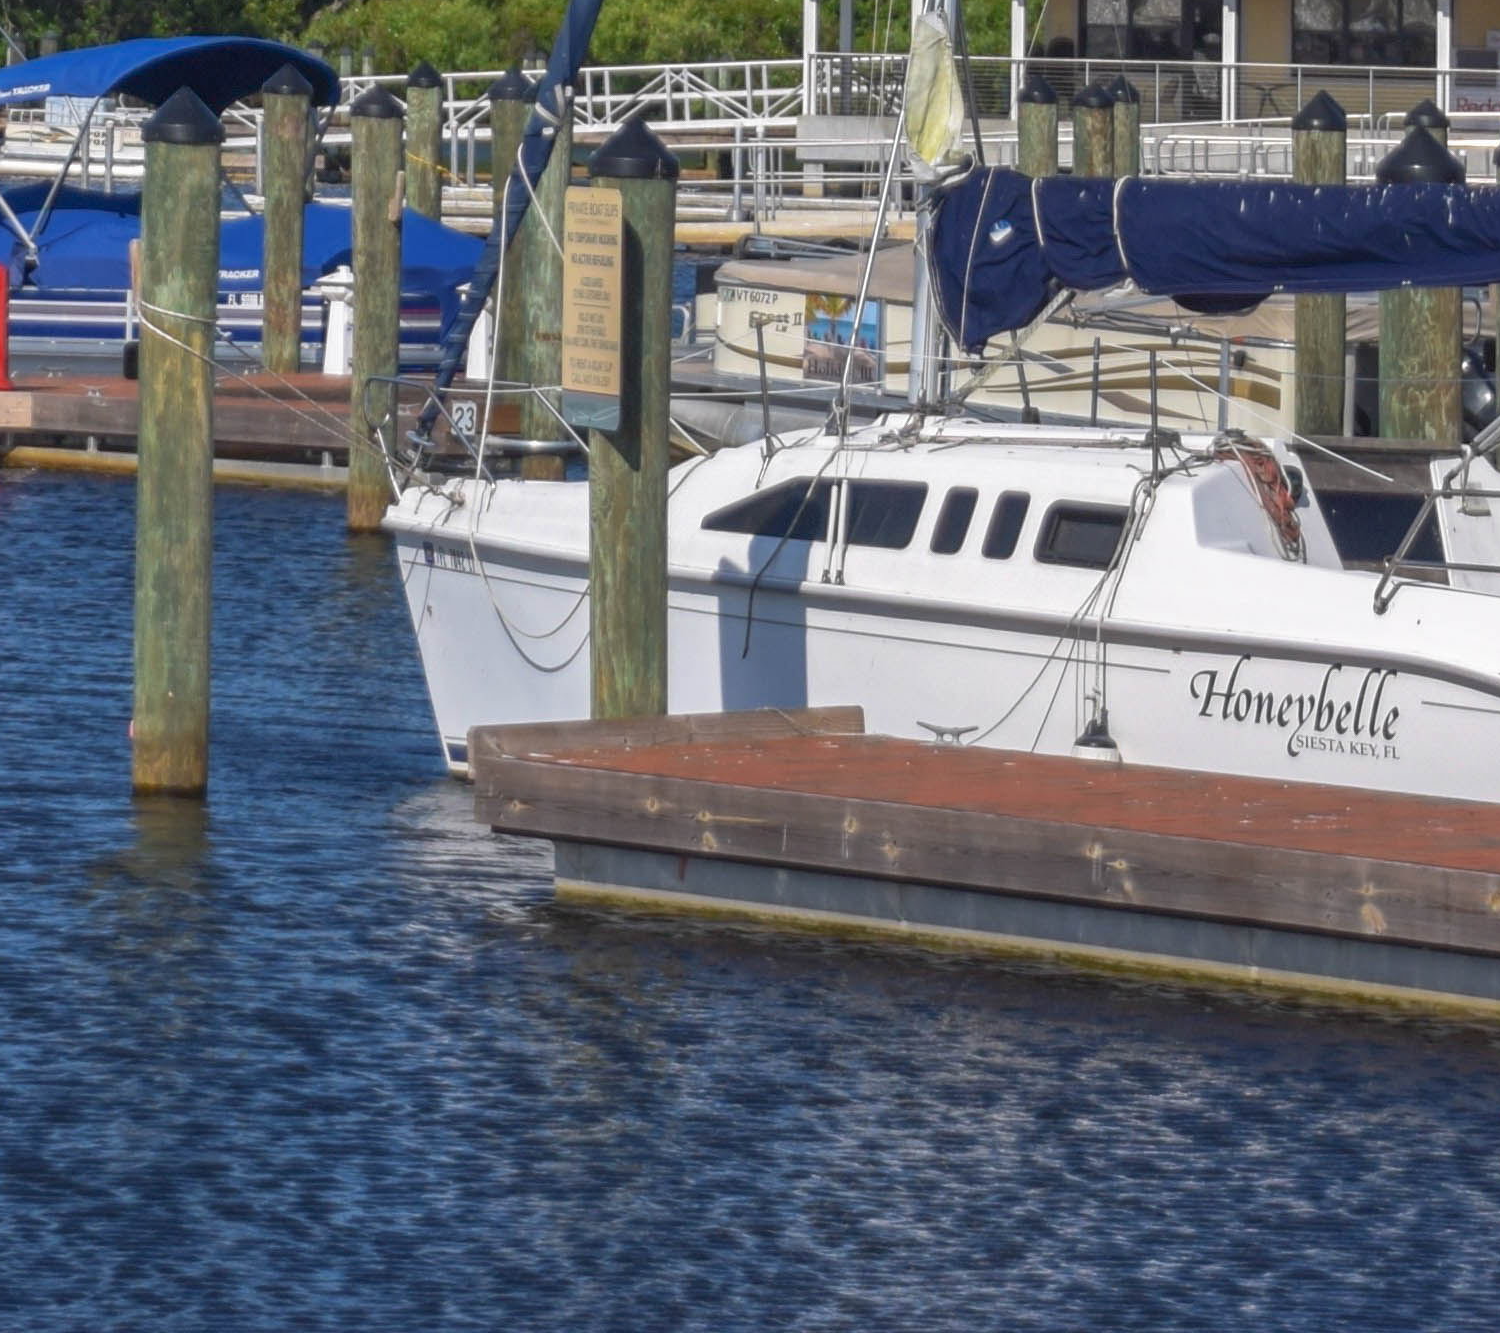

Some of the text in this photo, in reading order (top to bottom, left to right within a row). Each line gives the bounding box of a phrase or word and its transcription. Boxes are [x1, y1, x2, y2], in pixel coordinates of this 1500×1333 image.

[772, 294, 778, 305] P
[455, 406, 474, 431] 23
[1190, 652, 1400, 758] Honeybelle
[1296, 734, 1400, 760] SIESTA KEY, FL
